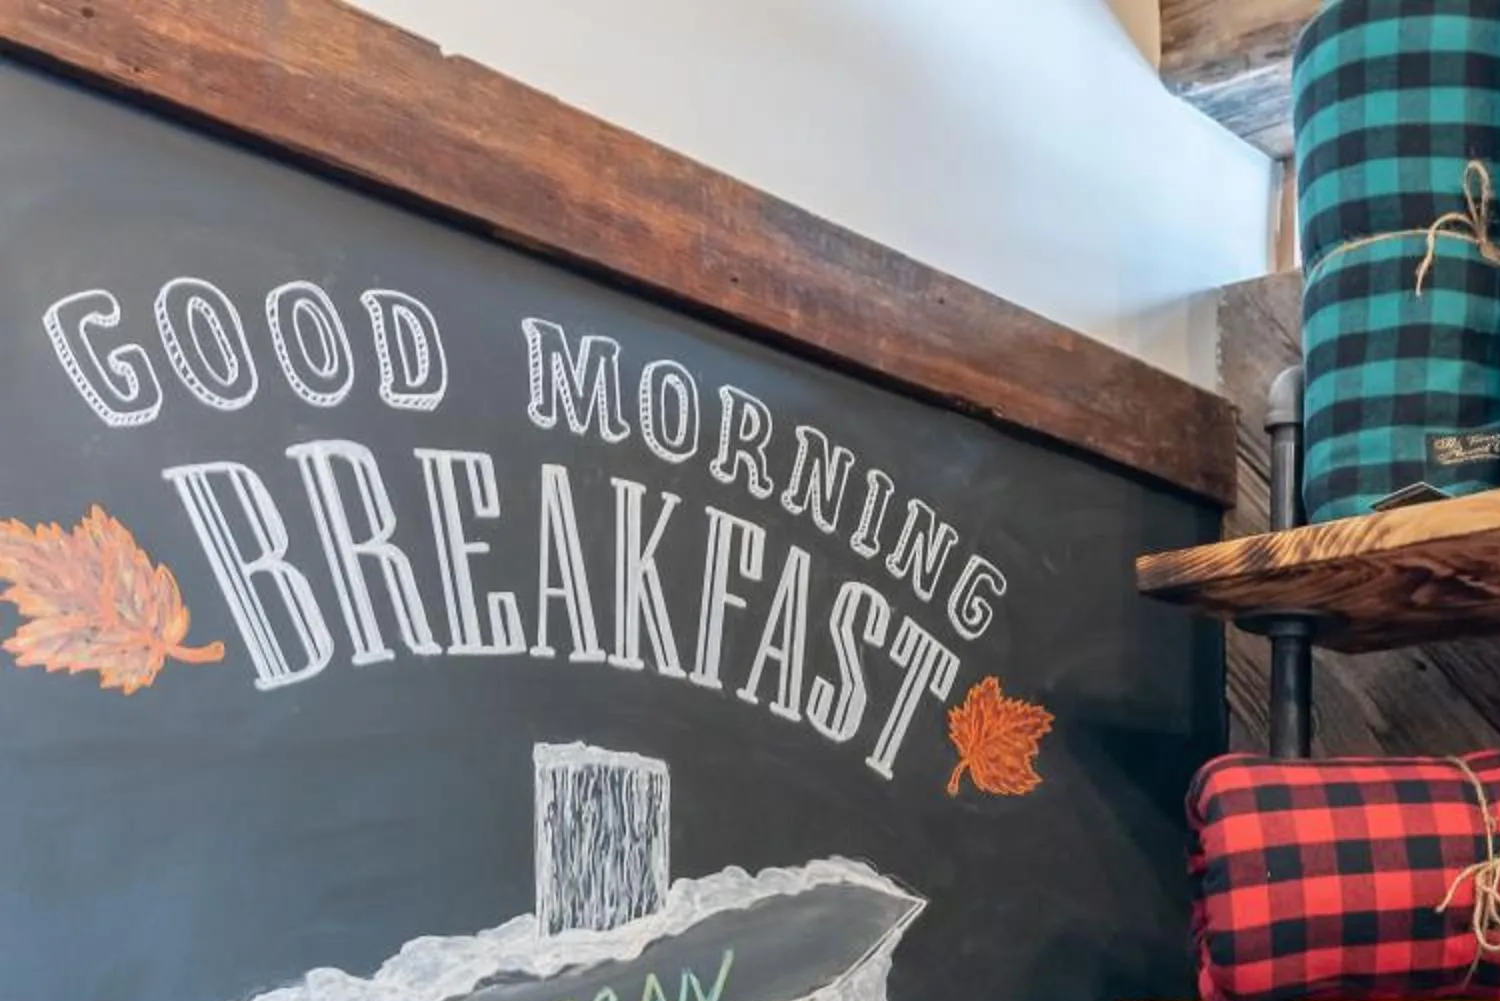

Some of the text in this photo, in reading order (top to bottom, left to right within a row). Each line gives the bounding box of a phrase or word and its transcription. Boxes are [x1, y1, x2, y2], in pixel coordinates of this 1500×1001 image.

[43, 277, 1008, 640] GOOD MORNING
[161, 439, 961, 781] BREAKFAST
